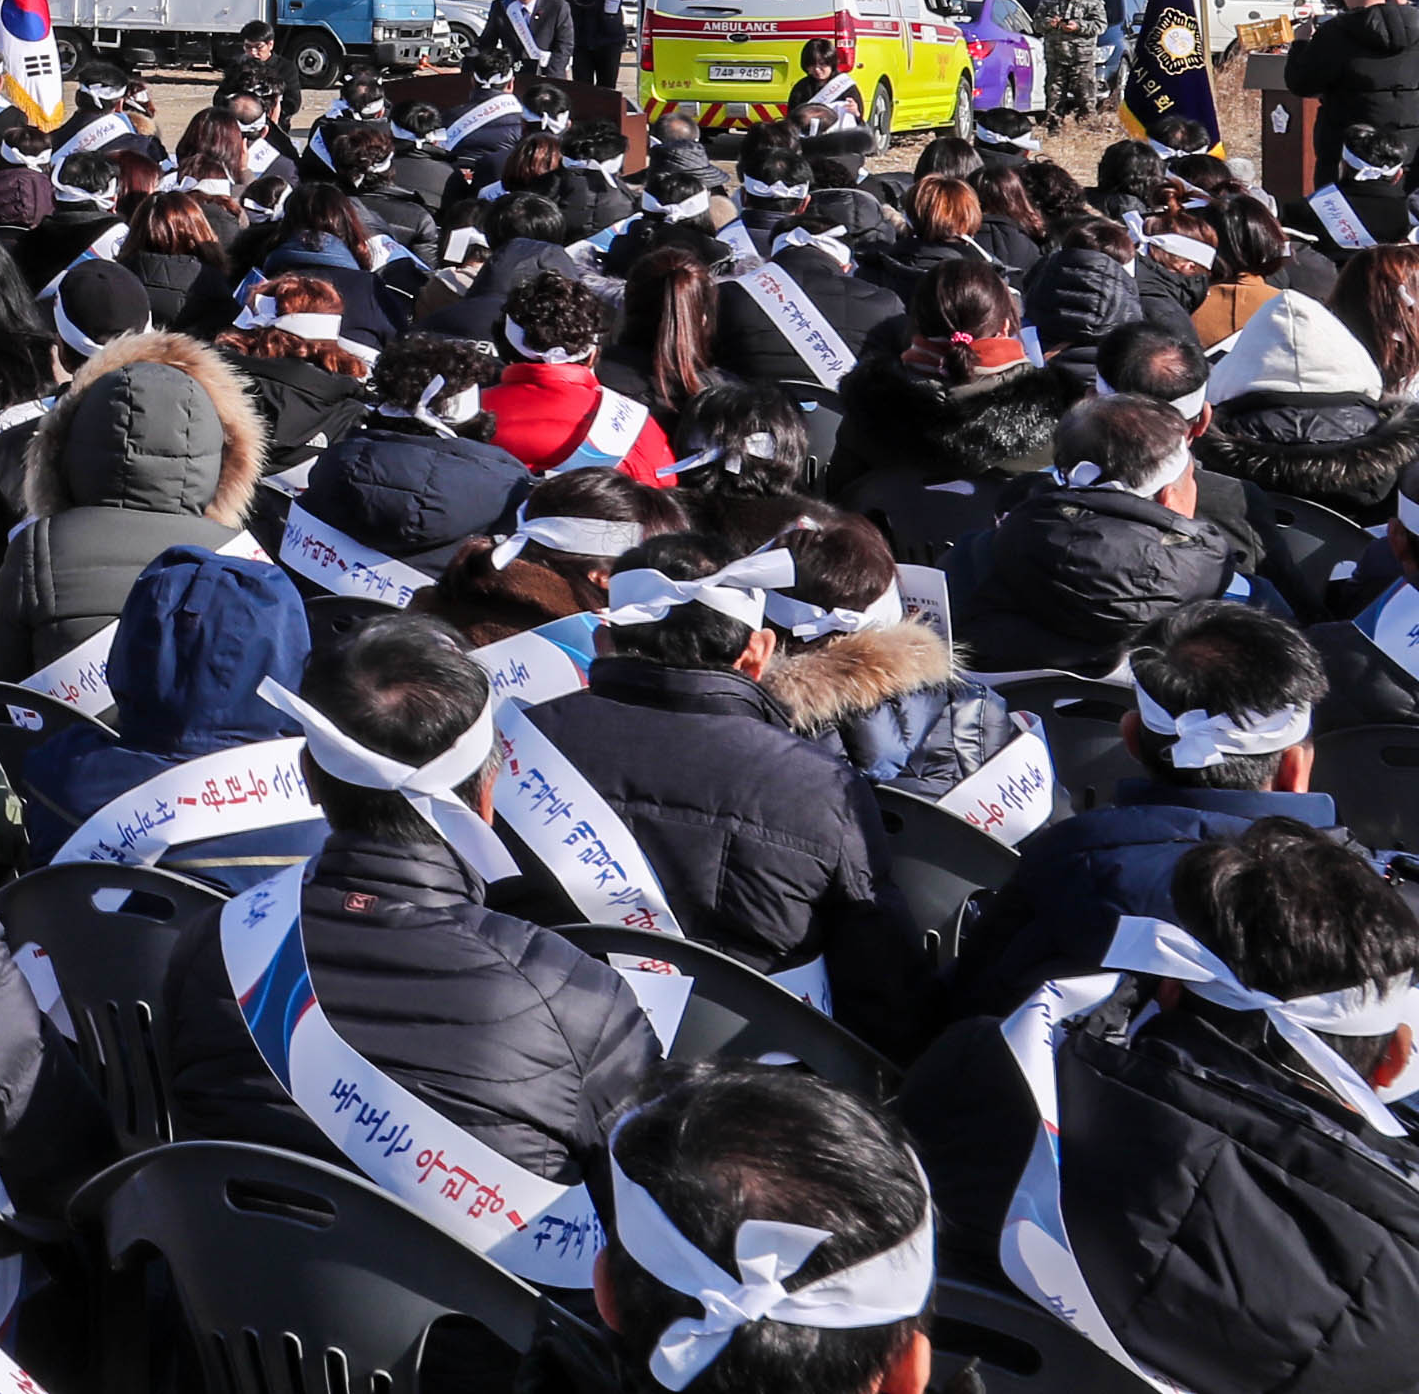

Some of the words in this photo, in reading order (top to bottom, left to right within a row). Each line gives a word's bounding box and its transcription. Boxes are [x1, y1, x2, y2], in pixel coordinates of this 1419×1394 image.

[703, 20, 778, 33] AMBULANCE
[177, 769, 269, 813] 우리땅!
[515, 768, 573, 826] 서부두
[561, 819, 643, 907] 매립지는
[329, 1078, 414, 1158] 독도는
[415, 1149, 529, 1233] 우리땅!
